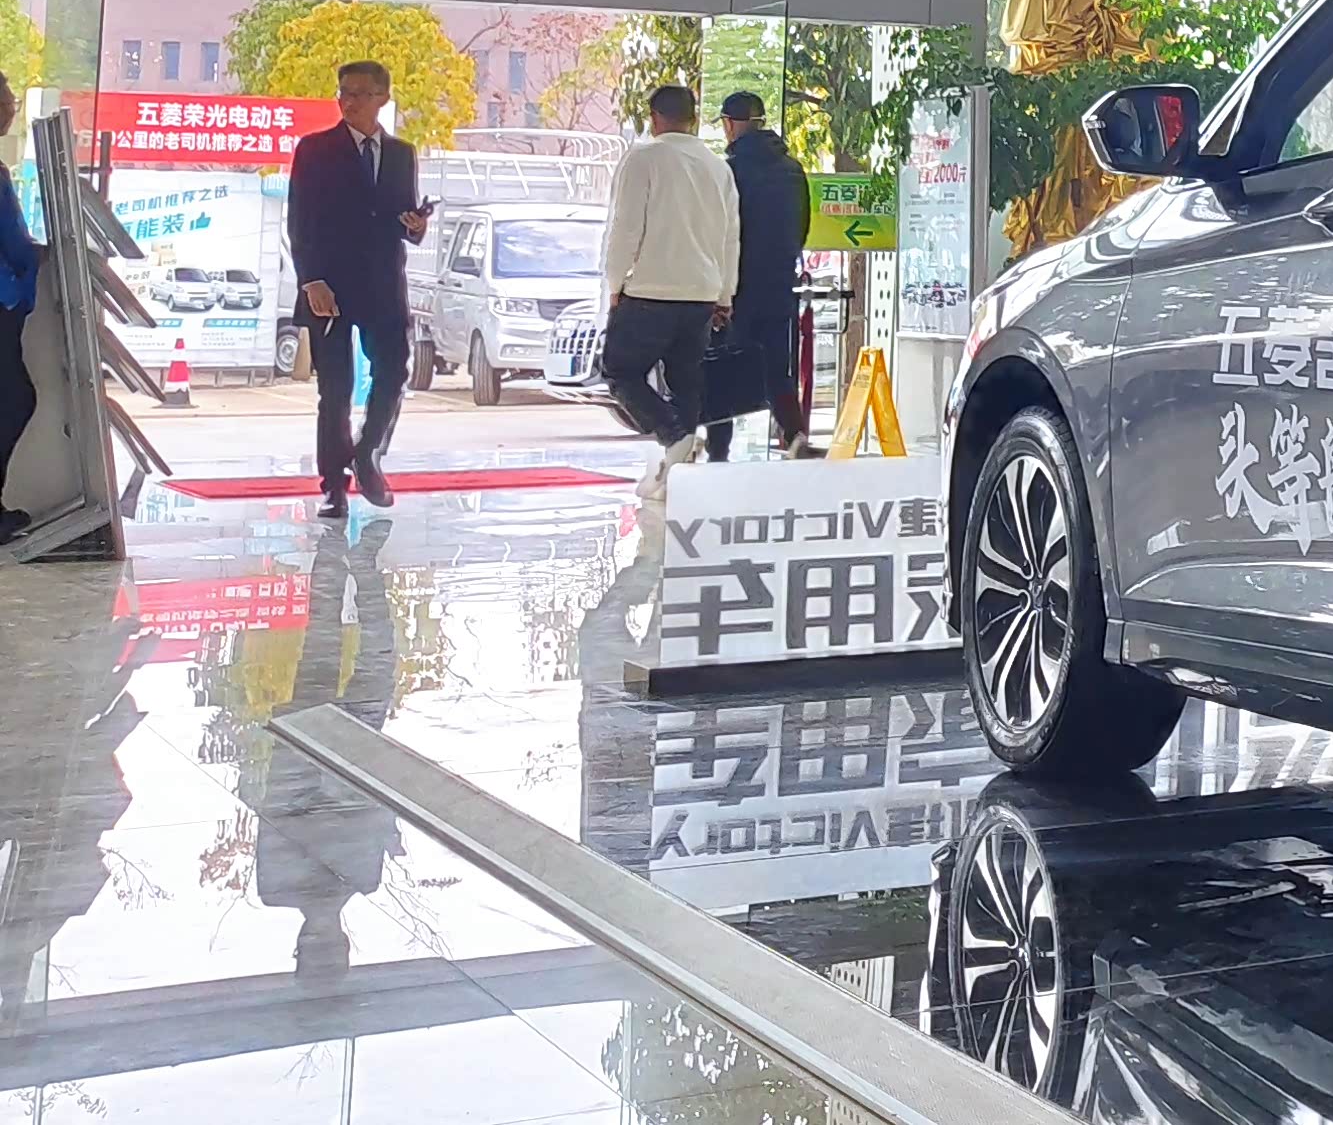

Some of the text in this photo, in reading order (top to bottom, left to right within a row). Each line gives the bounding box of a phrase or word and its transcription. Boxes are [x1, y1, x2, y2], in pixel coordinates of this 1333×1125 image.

[136, 102, 295, 130] 五菱荣光电动车
